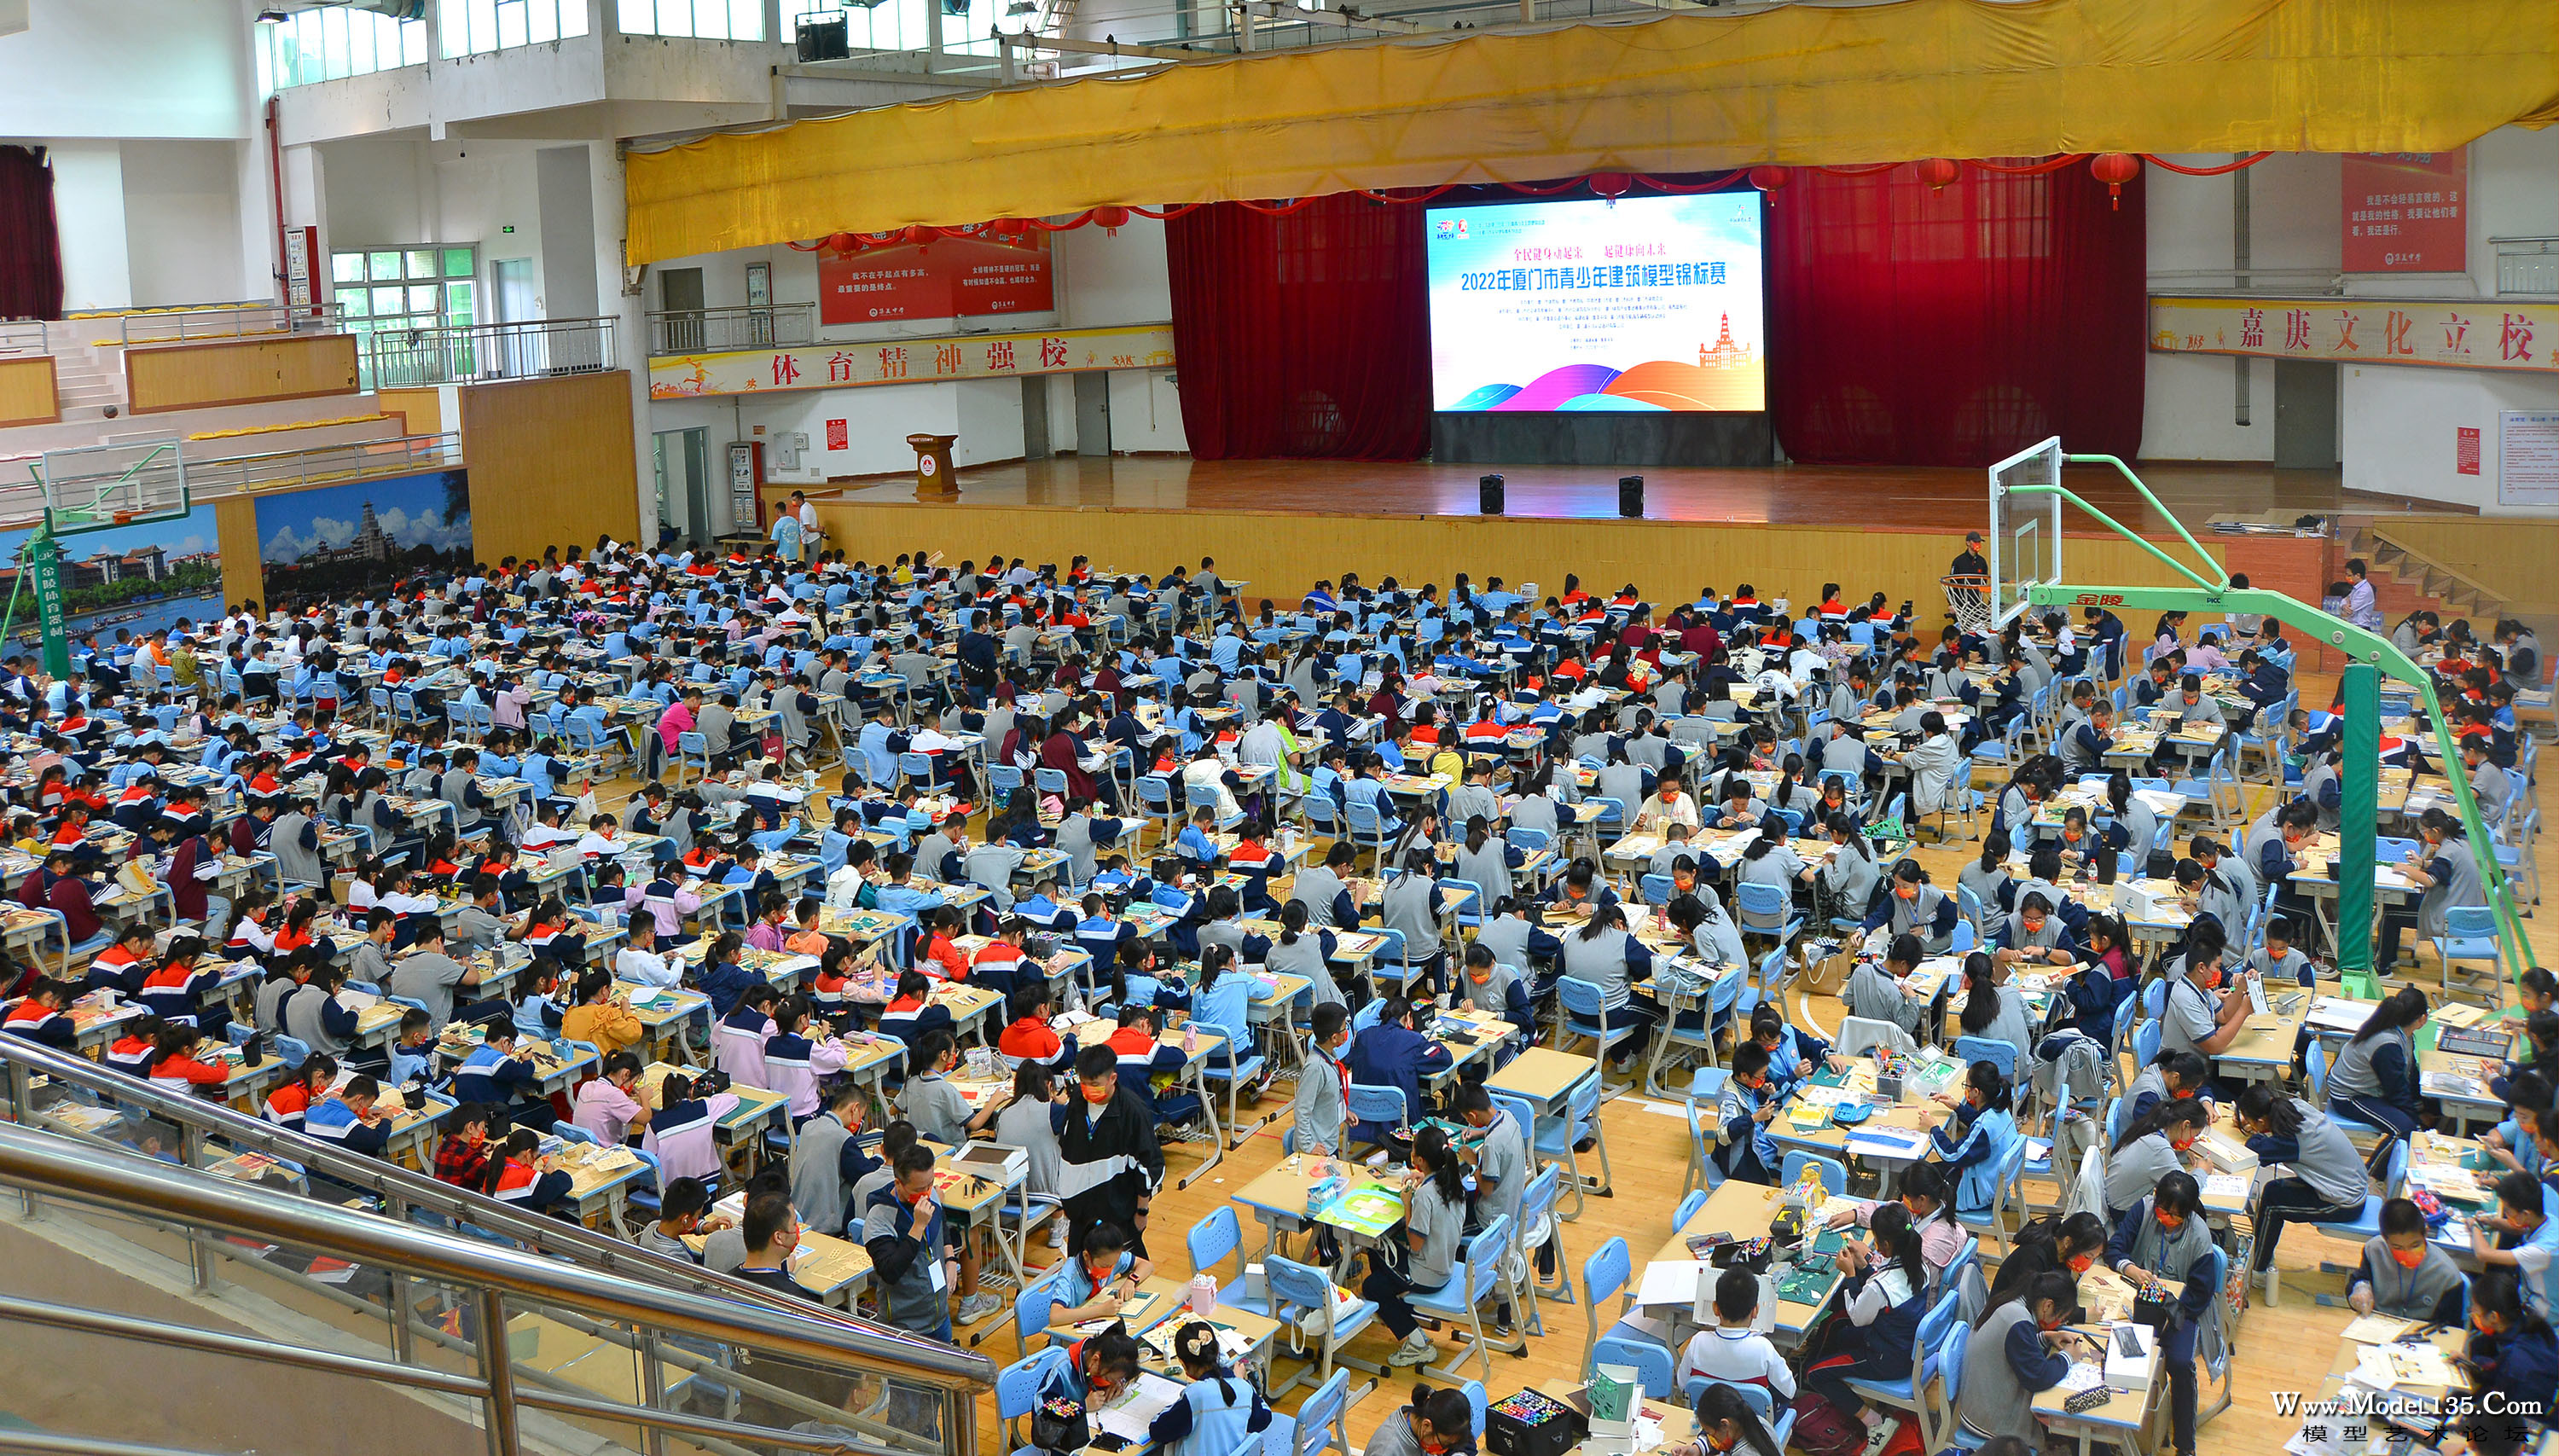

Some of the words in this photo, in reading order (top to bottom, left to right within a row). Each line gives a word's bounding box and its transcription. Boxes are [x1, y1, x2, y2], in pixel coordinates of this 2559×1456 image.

[1514, 247, 1583, 262] 全民健身动起来
[1461, 262, 1726, 291] 2022年厦门市青少年建筑模型锦标赛
[2240, 307, 2534, 362] 嘉庚文化立校
[771, 337, 1068, 386] 体育精神强校
[42, 566, 64, 638] 金陵体育器材
[2075, 594, 2125, 606] 金陵
